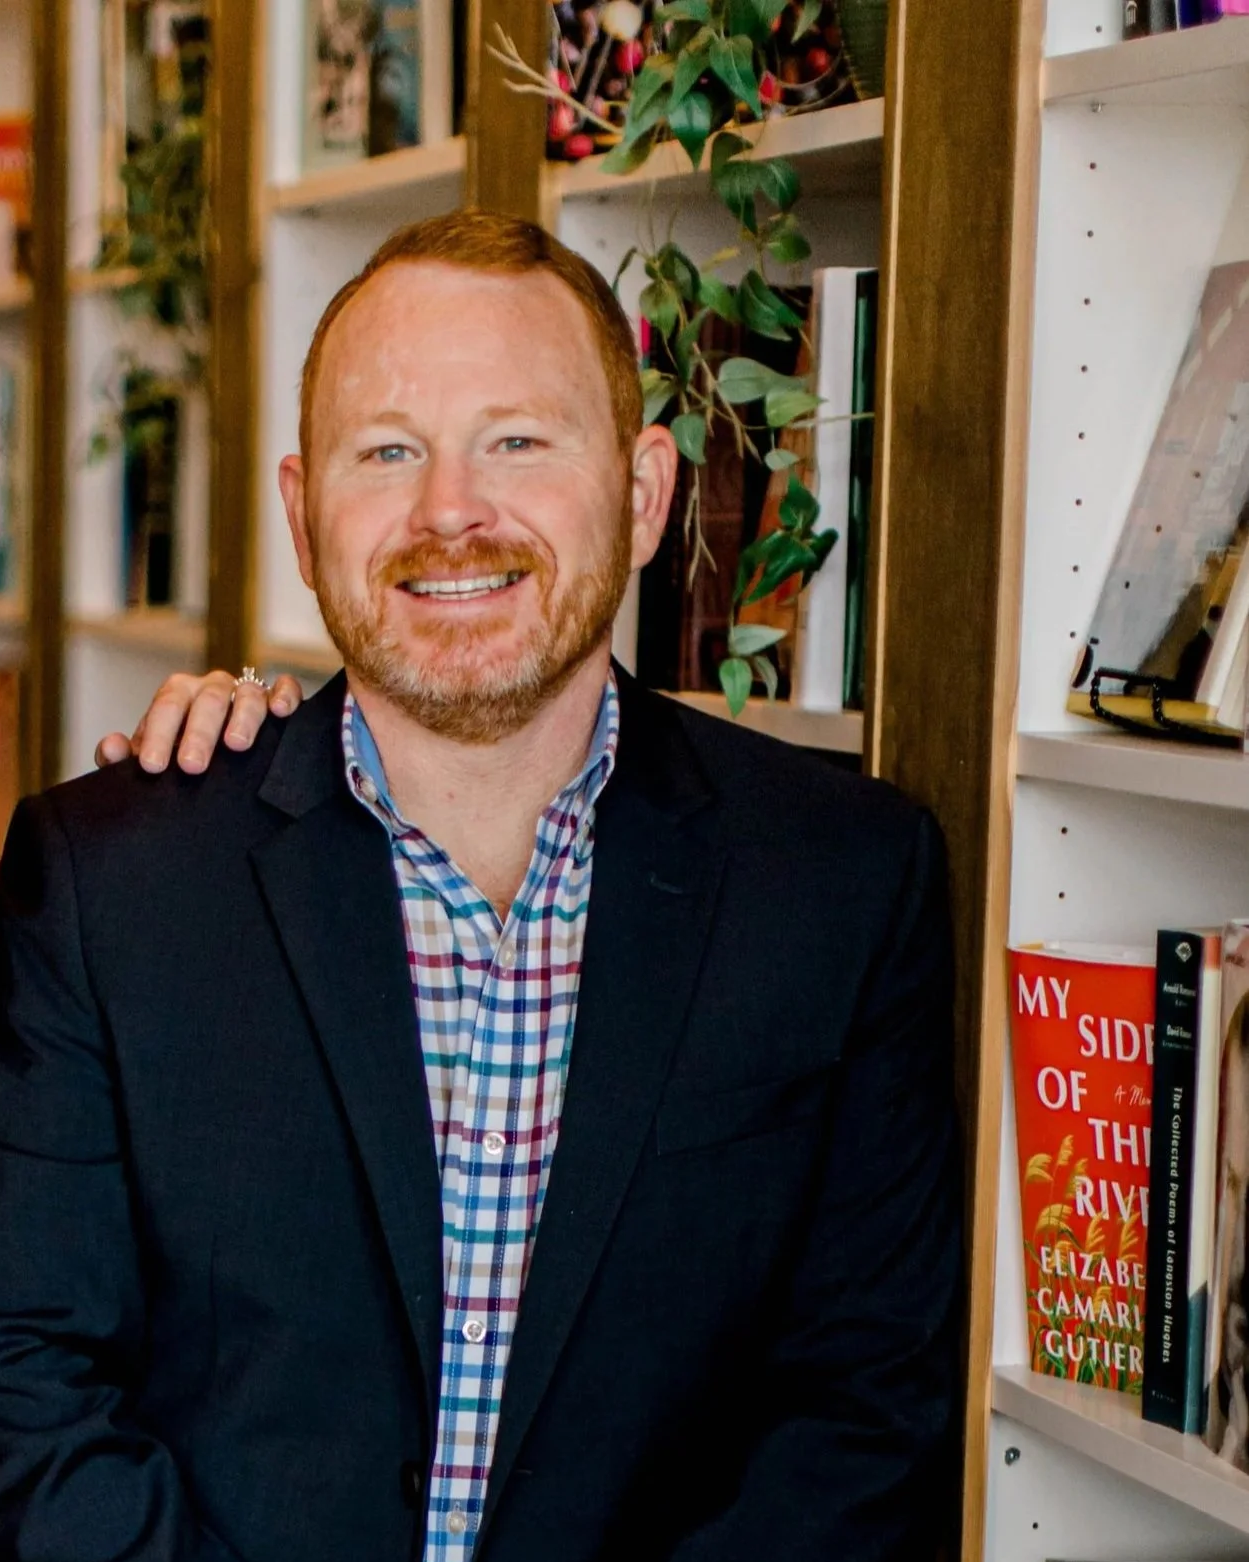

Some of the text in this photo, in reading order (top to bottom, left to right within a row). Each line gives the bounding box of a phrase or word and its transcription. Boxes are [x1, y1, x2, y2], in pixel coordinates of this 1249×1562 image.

[1017, 973, 1071, 1020] MY
[1037, 1066, 1088, 1112] OF
[1161, 1086, 1183, 1364] The Collected Poems of Langston Hughes
[1045, 1329, 1144, 1375] GUTIER
